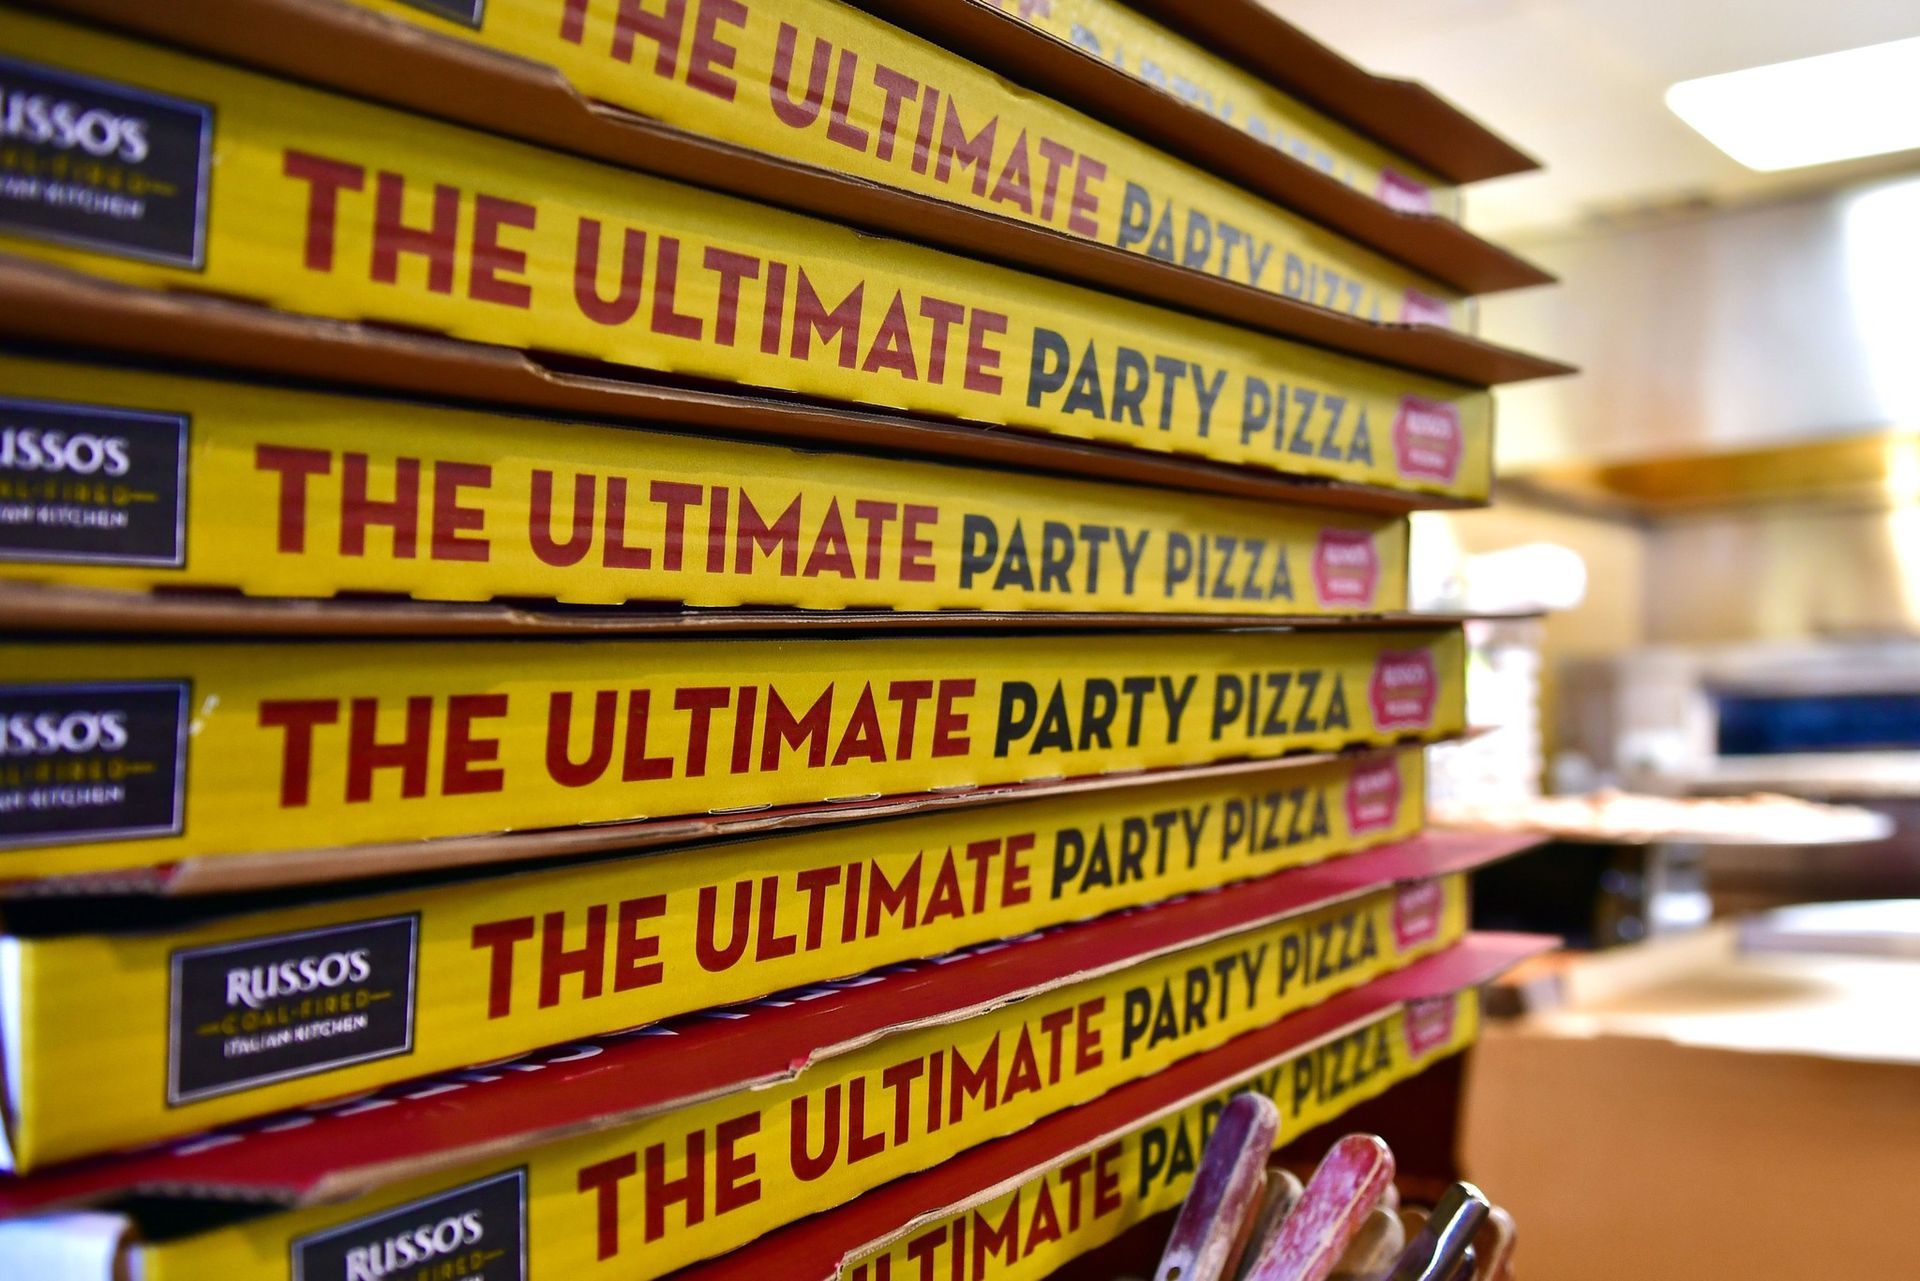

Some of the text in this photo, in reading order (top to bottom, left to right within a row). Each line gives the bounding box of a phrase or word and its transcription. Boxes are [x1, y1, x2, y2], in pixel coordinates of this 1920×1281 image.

[769, 21, 1108, 239] ULTIMATE
[283, 148, 537, 310] THE
[574, 217, 1009, 395] ULTIMATE
[1026, 326, 1228, 440] PARTY
[1239, 375, 1375, 468] PIZZA
[255, 443, 492, 563] THE
[528, 469, 940, 583] ULTIMATE
[958, 513, 1150, 595] PARTY
[1164, 531, 1296, 602] PIZZA
[258, 693, 508, 808] THE
[545, 678, 977, 789] ULTIMATE
[993, 674, 1199, 758] PARTY
[1211, 669, 1351, 741] PIZZA
[226, 948, 371, 1009] RUSSO'S
[471, 894, 667, 1020] THE
[694, 832, 1036, 973] ULTIMATE
[1050, 803, 1211, 900] PARTY
[1220, 789, 1331, 863] PIZZA
[223, 1012, 369, 1059] ITALIAN KITCHEN
[578, 1110, 762, 1262] THE
[789, 997, 1106, 1182] ULTIMATE
[1120, 943, 1271, 1061] PARTY
[1277, 911, 1380, 998] PIZZA
[1290, 1022, 1392, 1119] PIZZA
